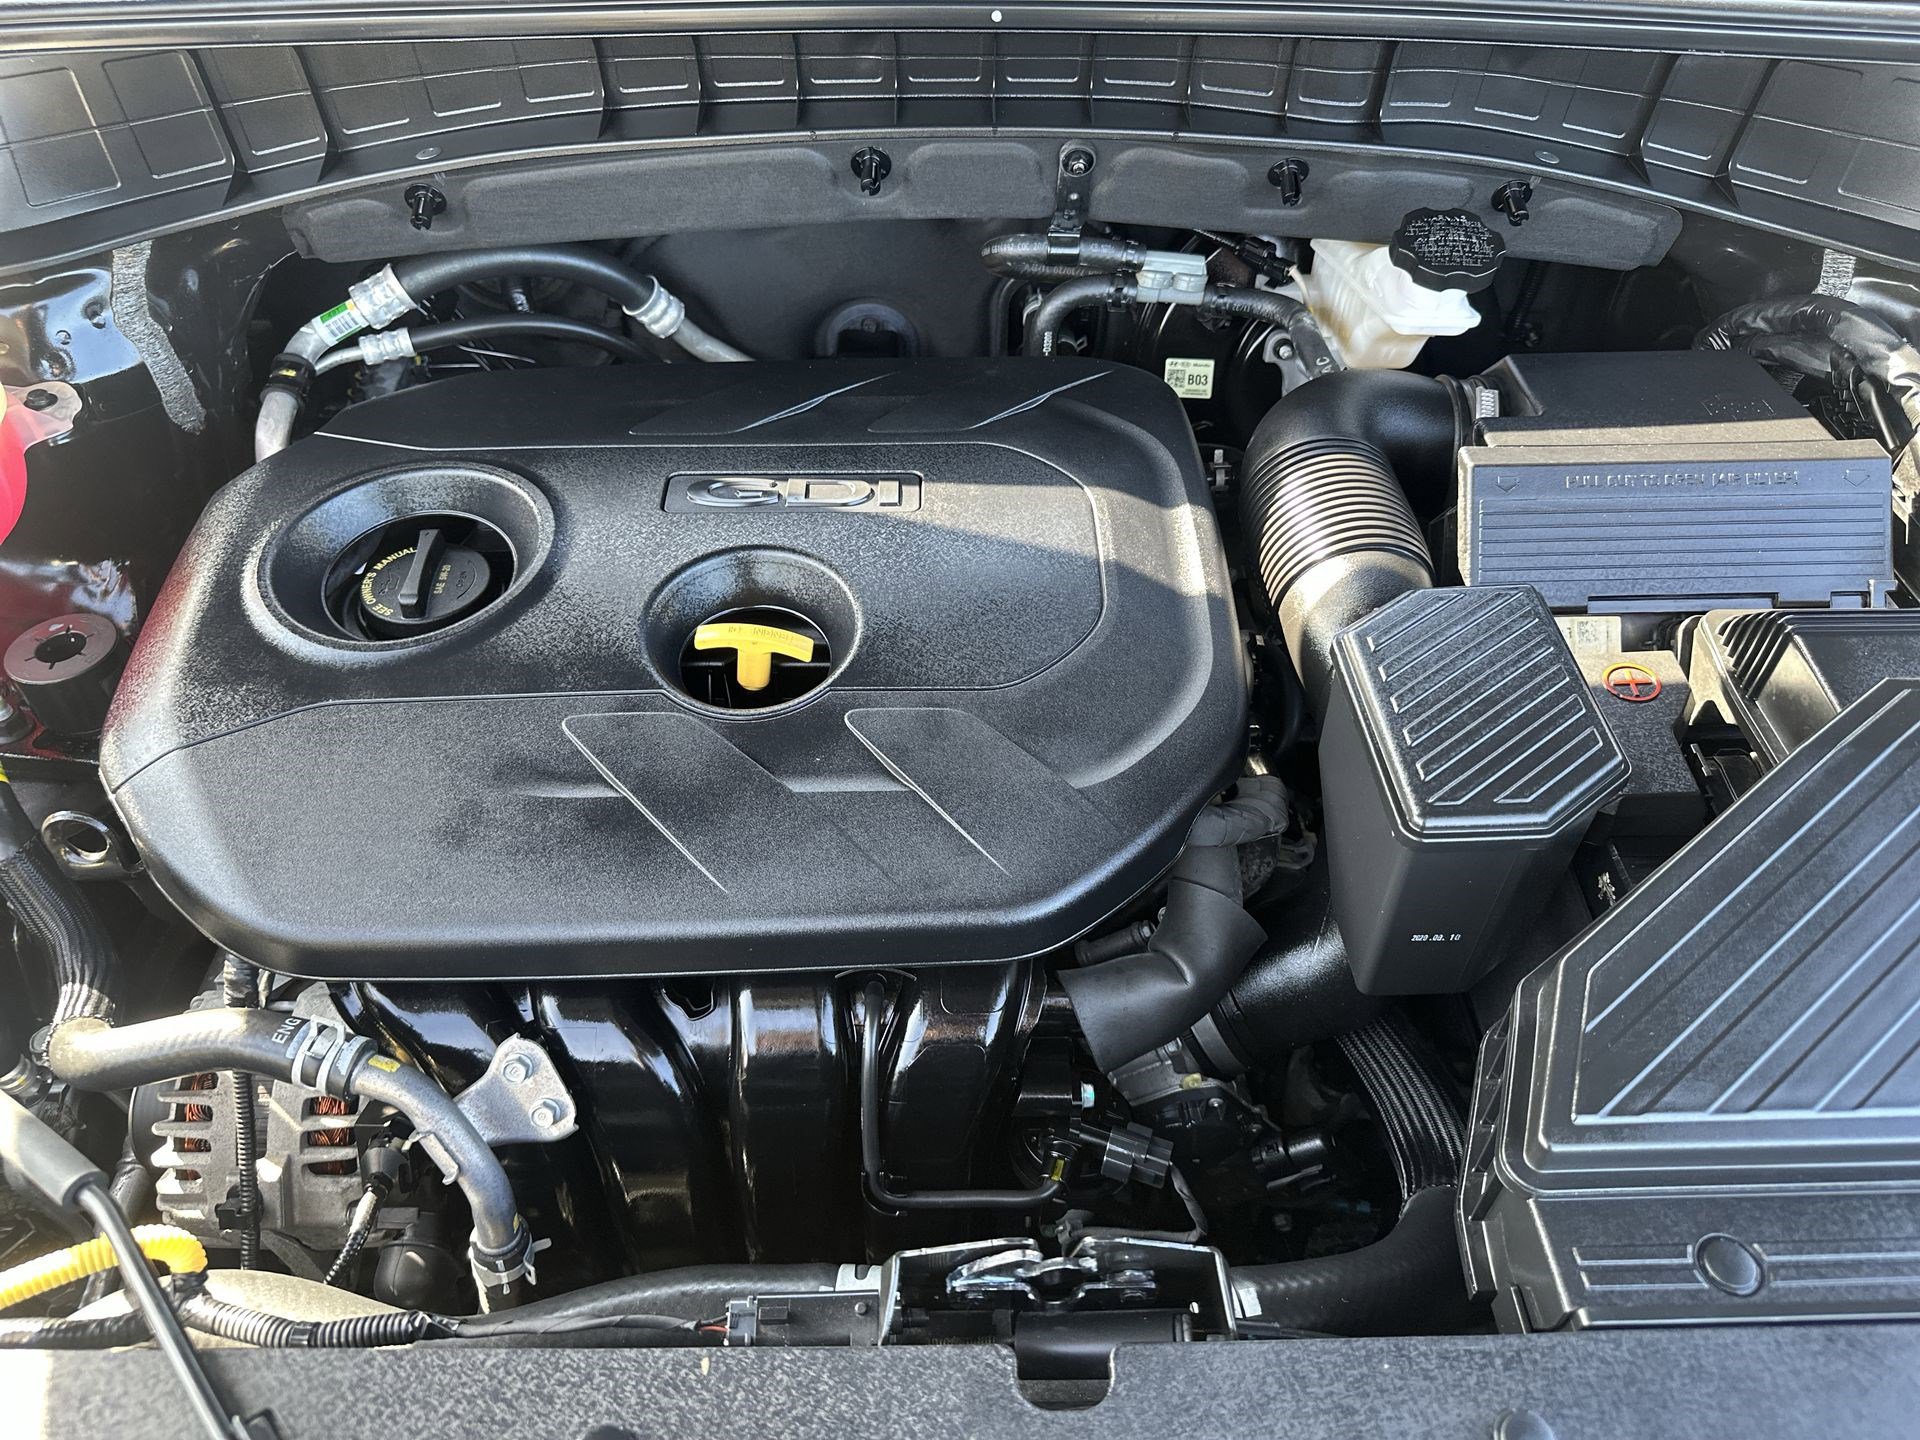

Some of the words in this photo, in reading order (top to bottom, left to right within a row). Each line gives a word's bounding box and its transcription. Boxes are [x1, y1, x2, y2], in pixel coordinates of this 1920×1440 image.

[1187, 374, 1208, 386] B03
[1565, 475, 1602, 488] PULL
[1607, 474, 1638, 486] OUT
[1640, 474, 1661, 486] TO
[1664, 473, 1705, 486] OPEN
[686, 477, 901, 508] GDI
[373, 547, 418, 571] MANUAL
[360, 571, 377, 605] OWNER'S
[433, 582, 446, 595] SAE
[372, 603, 394, 616] SEE
[271, 1017, 302, 1045] ENG
